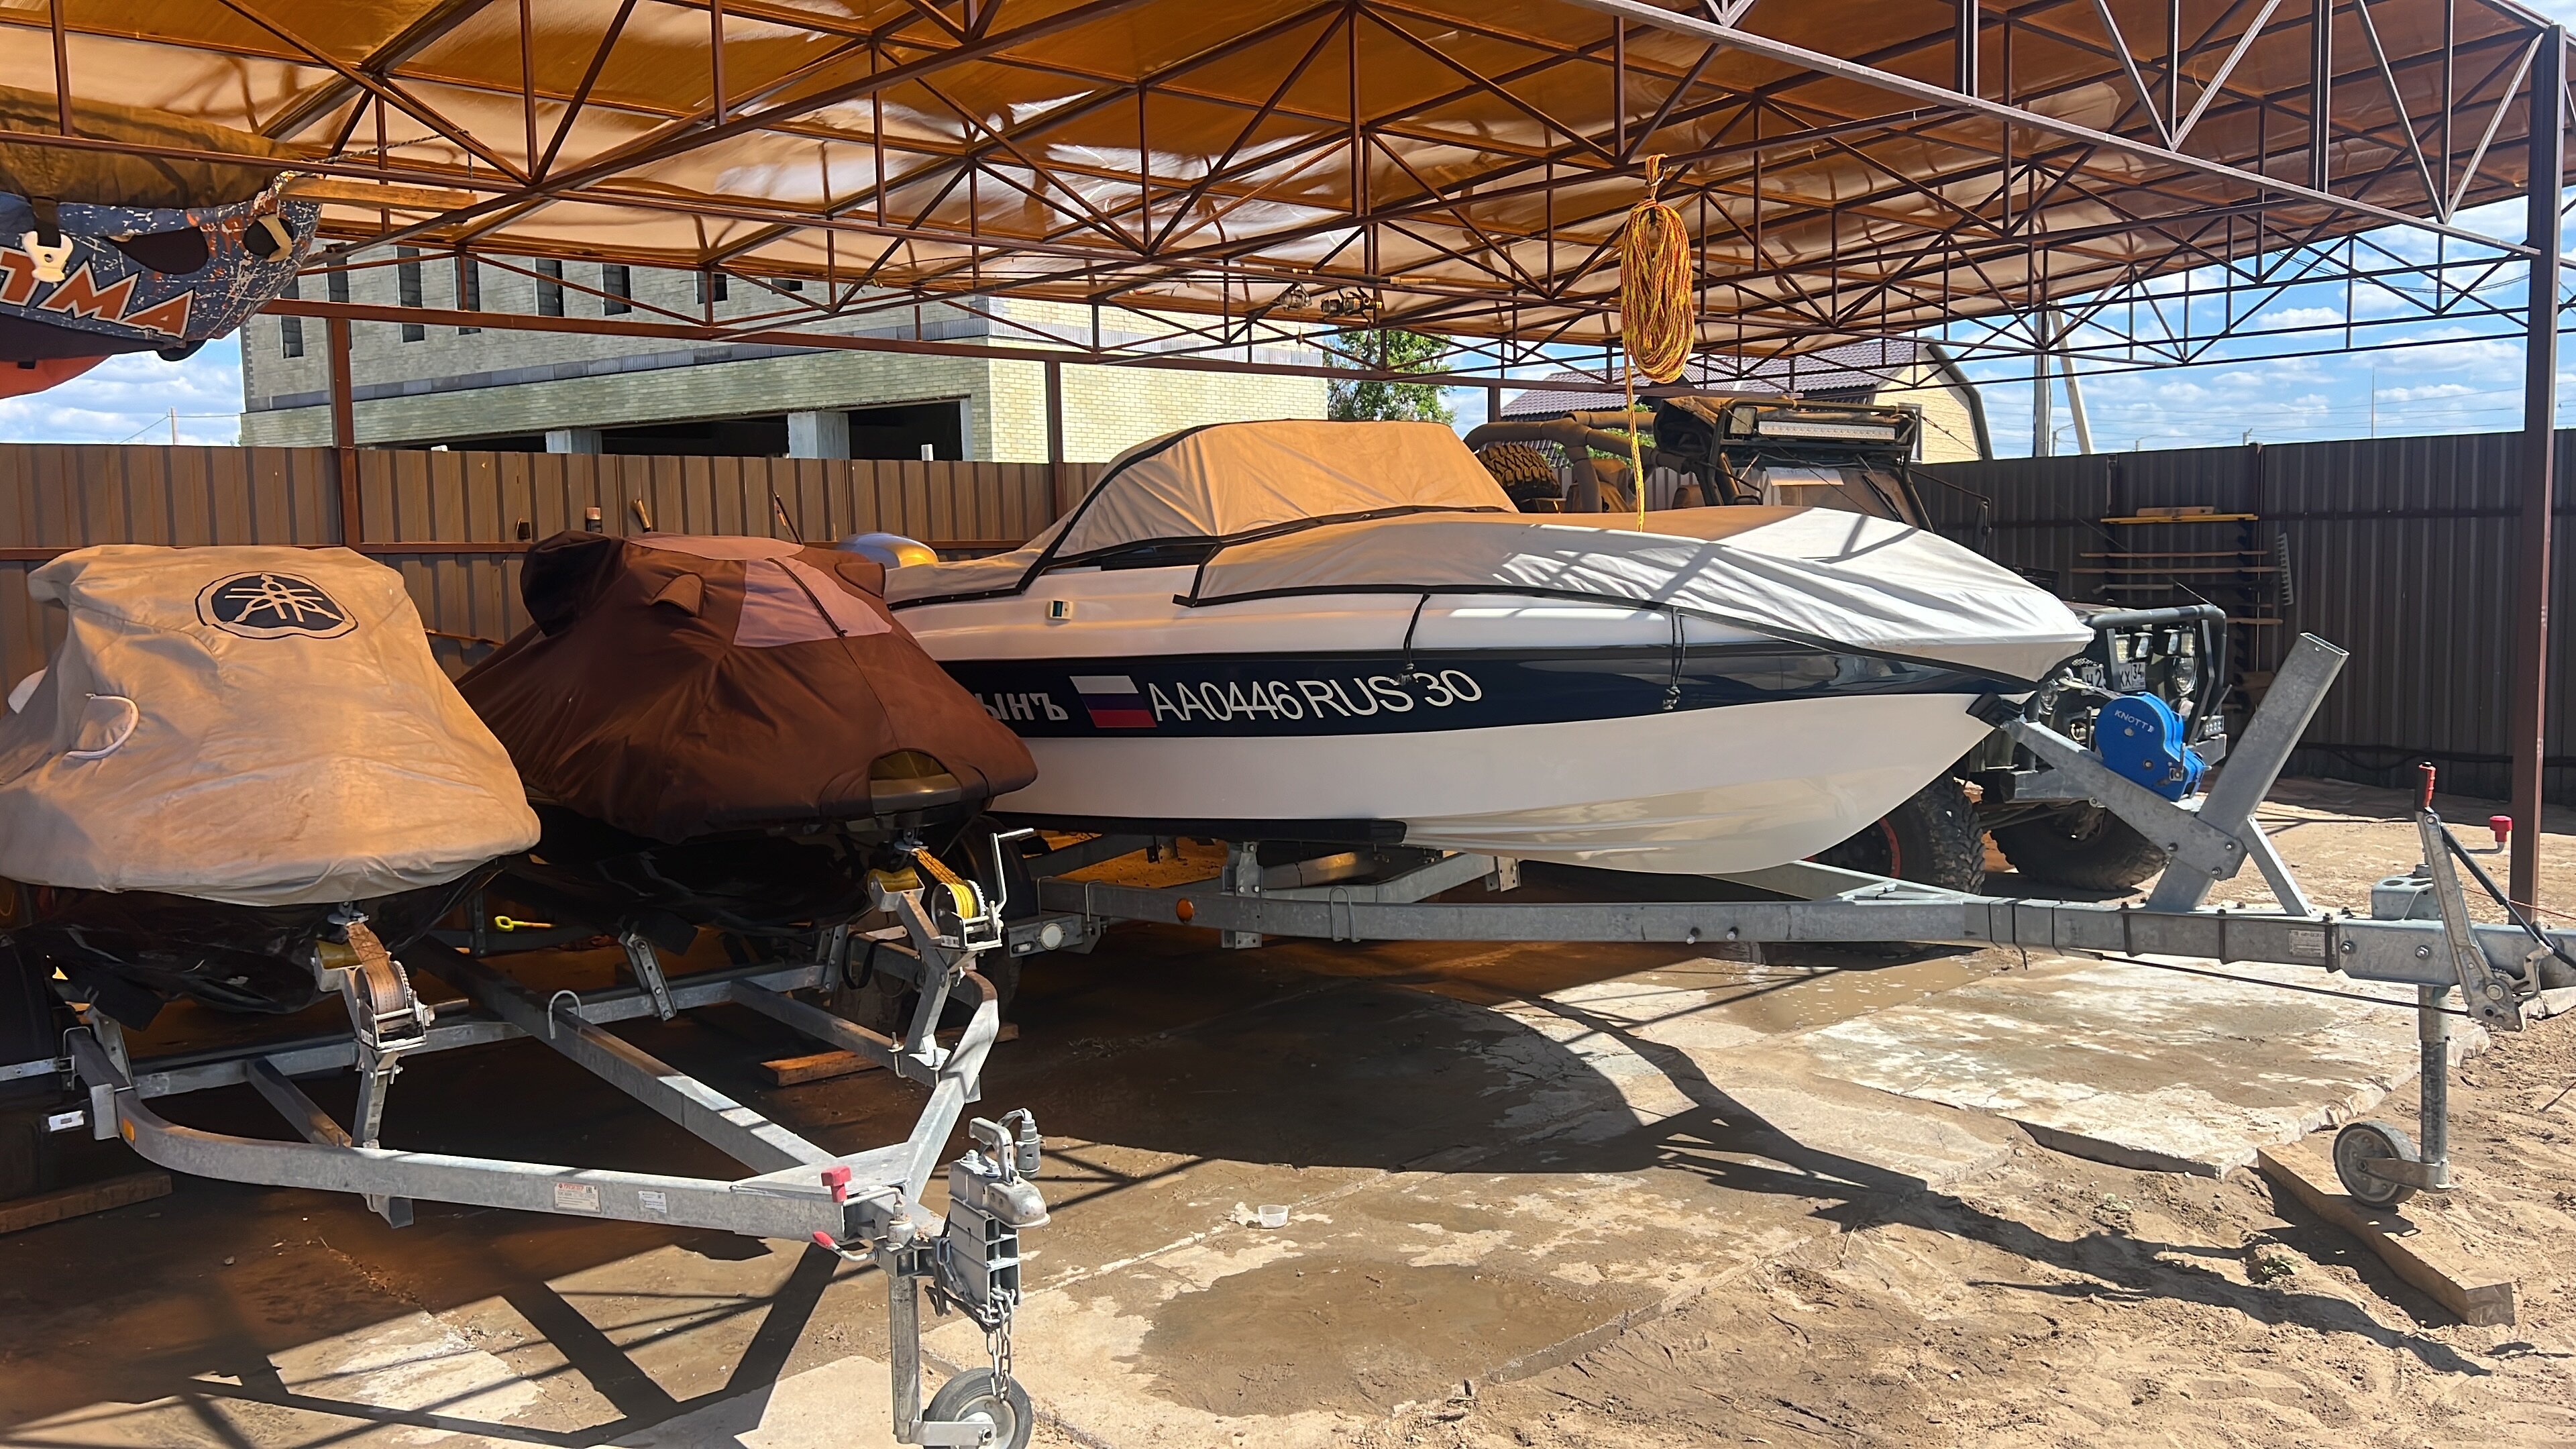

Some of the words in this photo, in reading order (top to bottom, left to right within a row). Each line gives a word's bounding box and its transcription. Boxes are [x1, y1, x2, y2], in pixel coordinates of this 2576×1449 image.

[1148, 682, 1303, 721] AA0446
[1296, 676, 1414, 718] RUS
[1409, 669, 1482, 706] 30
[2114, 709, 2149, 730] KNOTT
